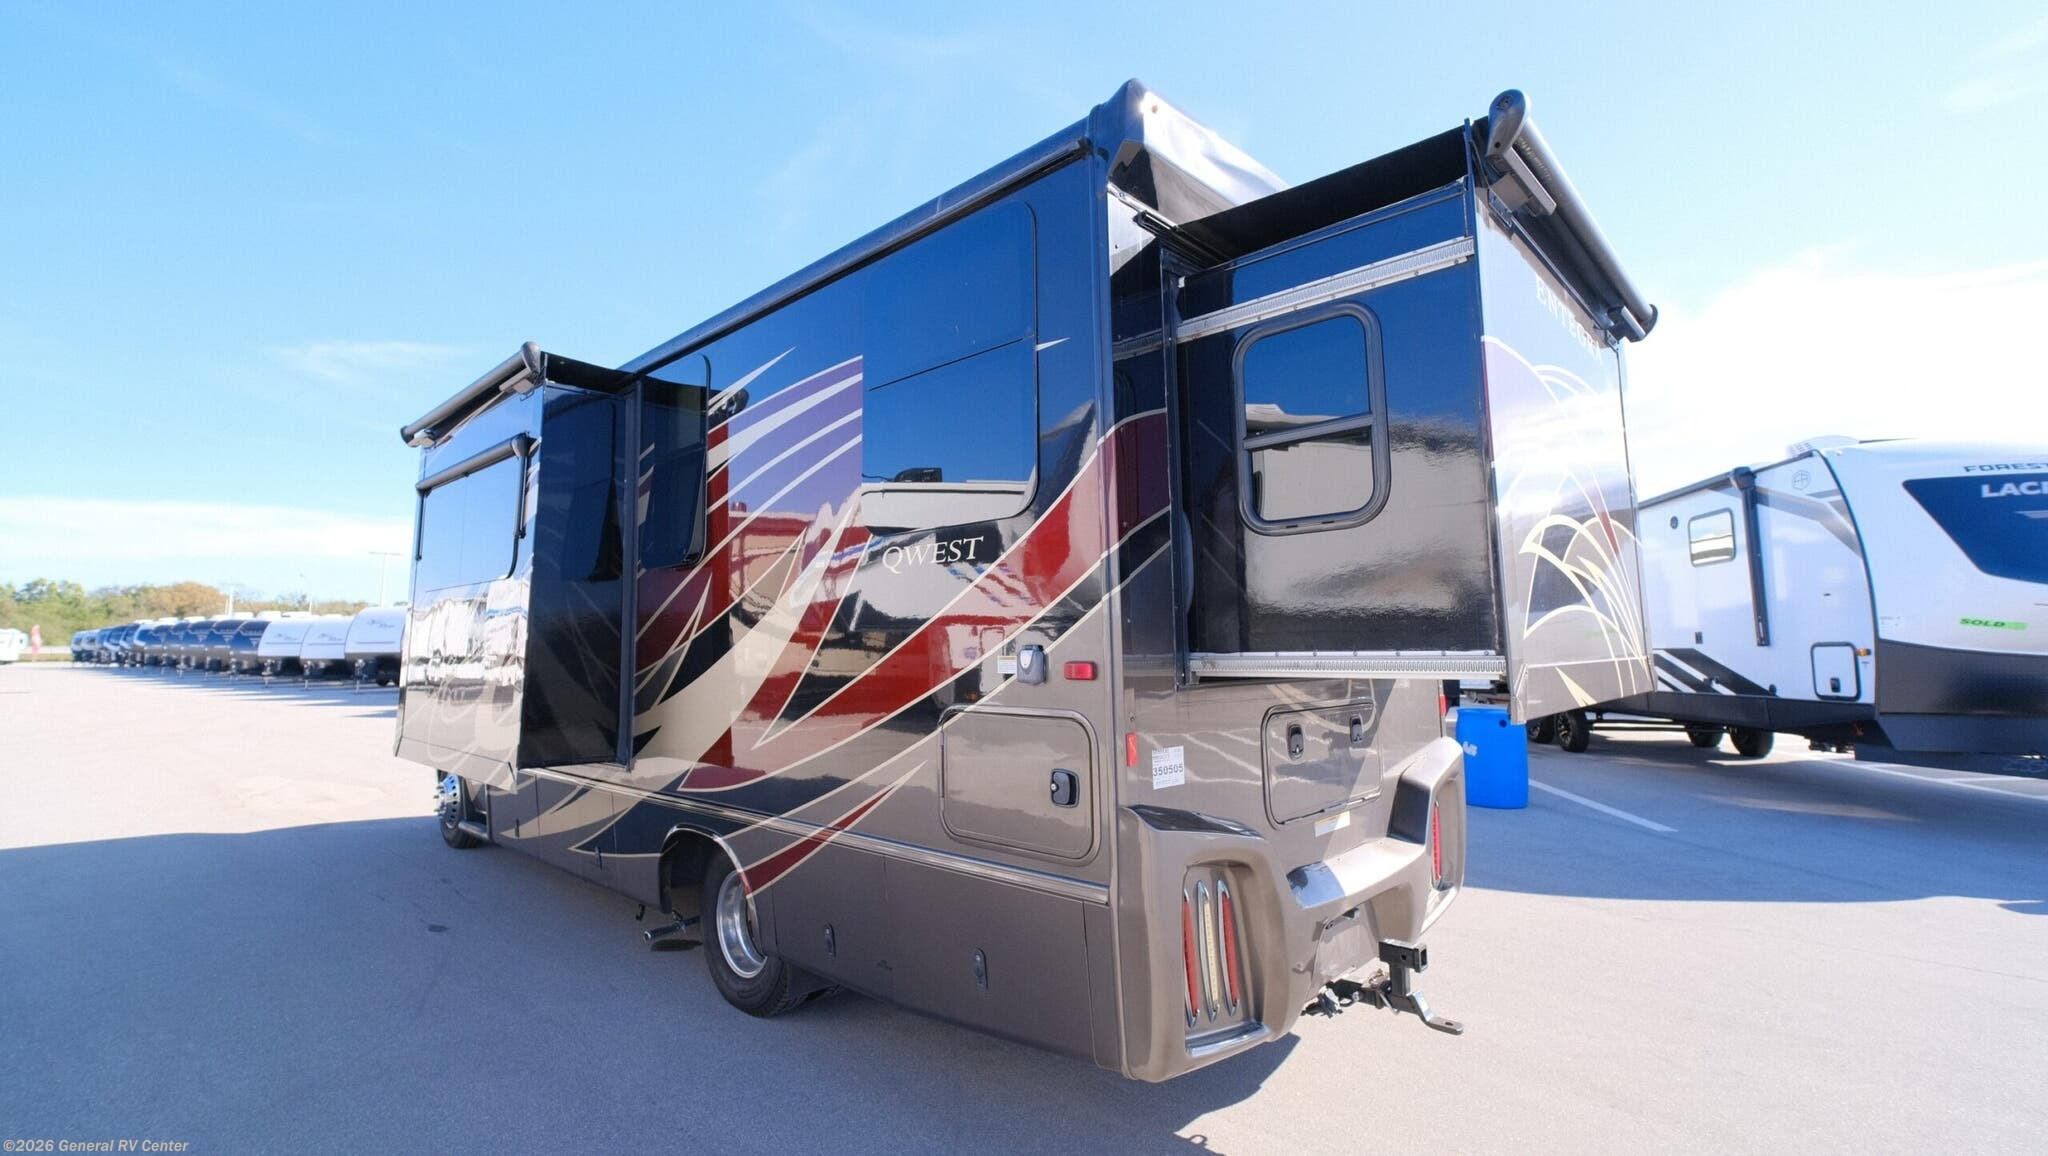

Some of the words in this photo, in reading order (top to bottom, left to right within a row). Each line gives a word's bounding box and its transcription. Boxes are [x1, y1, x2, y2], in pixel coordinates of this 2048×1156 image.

[882, 536, 984, 574] QWEST
[1960, 618, 2005, 627] SOLD
[1153, 764, 1184, 776] 350505
